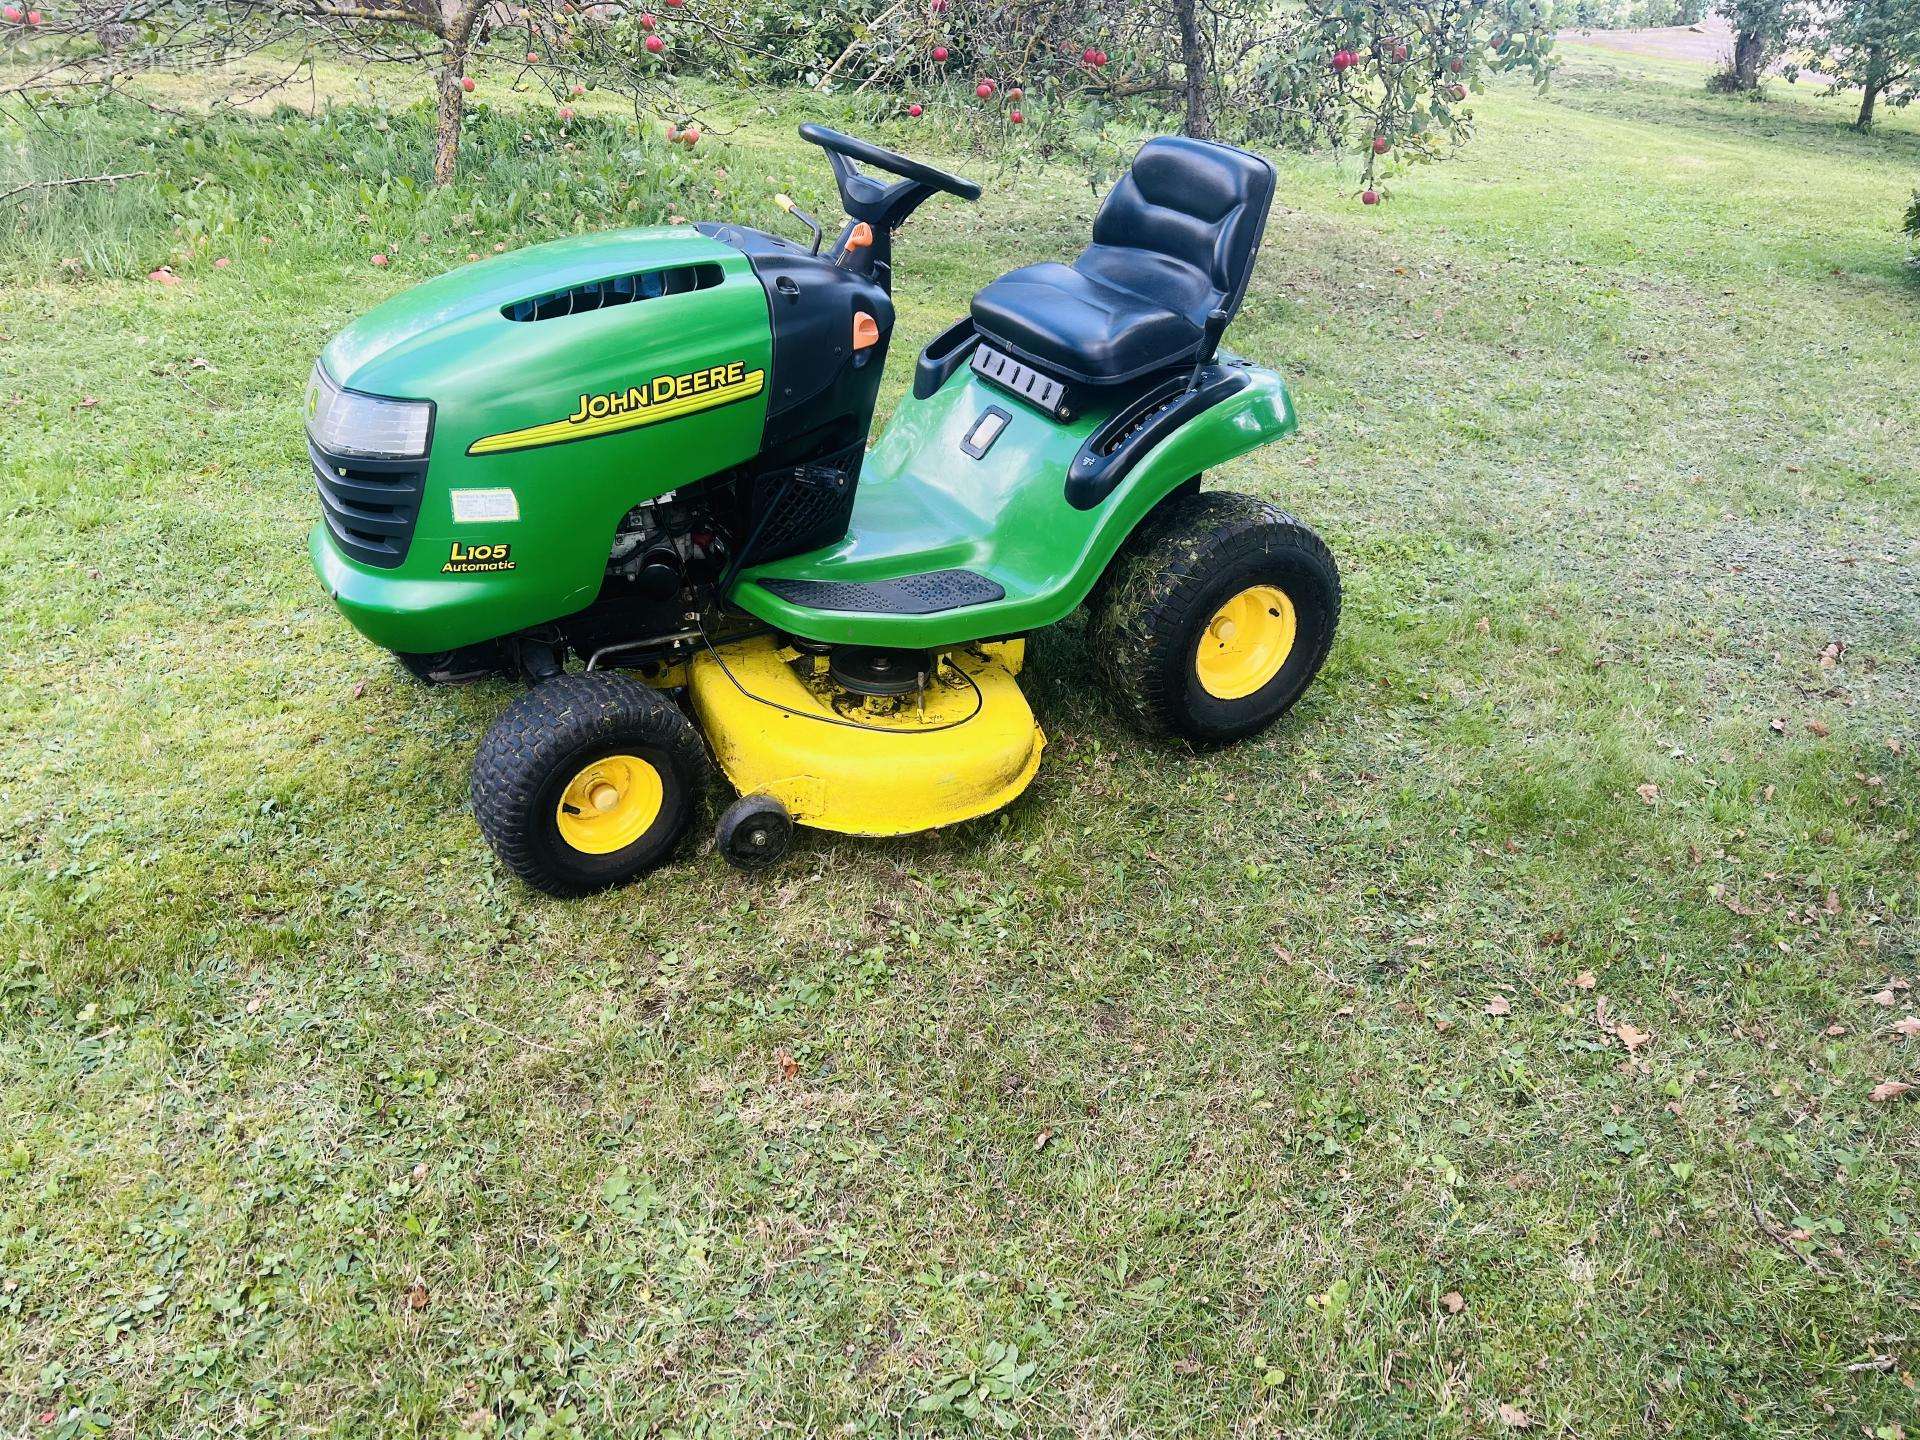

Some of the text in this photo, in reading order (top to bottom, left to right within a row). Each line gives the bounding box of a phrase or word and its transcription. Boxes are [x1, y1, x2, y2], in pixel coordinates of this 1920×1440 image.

[569, 361, 745, 423] JOHN DEERE
[450, 542, 510, 562] L105
[440, 559, 516, 574] Automatic
